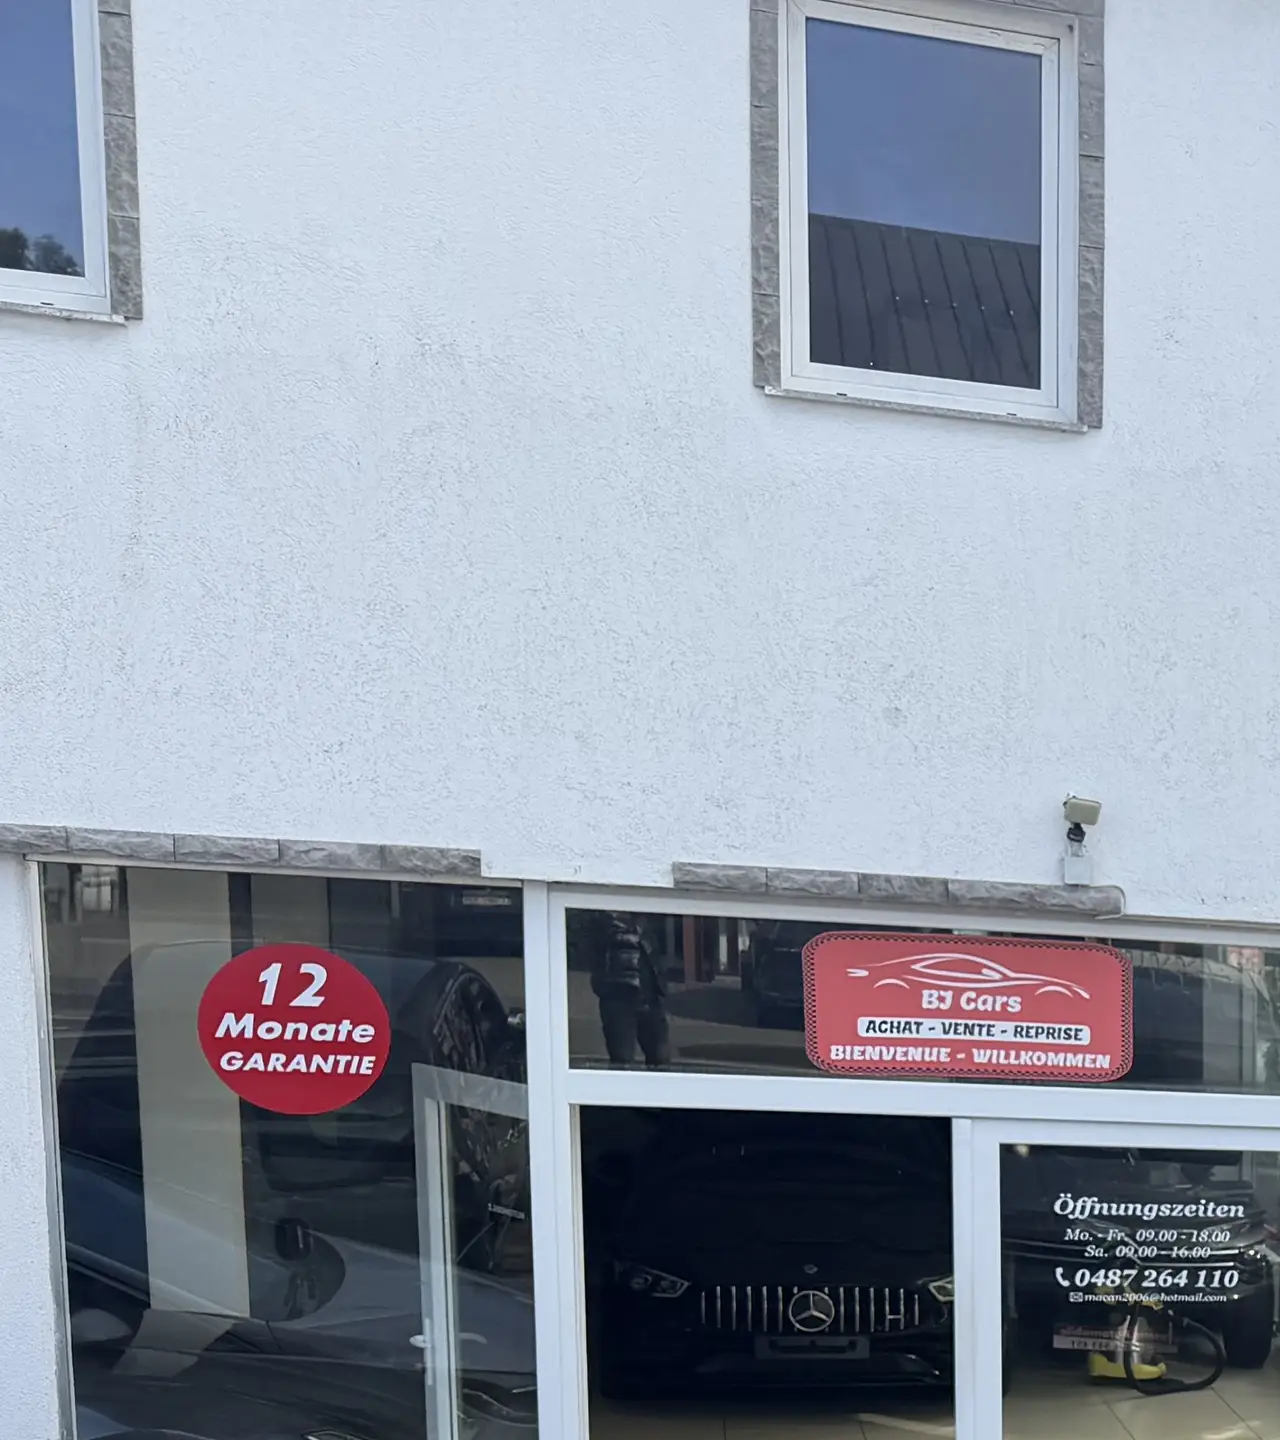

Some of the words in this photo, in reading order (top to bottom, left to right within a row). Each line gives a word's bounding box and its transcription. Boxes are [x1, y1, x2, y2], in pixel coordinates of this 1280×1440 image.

[258, 962, 328, 1008] 12
[921, 989, 953, 1010] BJ
[959, 991, 1022, 1013] Cars
[214, 1012, 376, 1044] Monate
[865, 1020, 924, 1036] ACHAT
[940, 1022, 996, 1038] VENTE
[1013, 1025, 1084, 1041] REPRISE
[219, 1051, 377, 1075] GARANTIE
[829, 1045, 952, 1063] BIENVENUE
[971, 1048, 1111, 1069] WILLKOMMEN
[1053, 1193, 1245, 1220] Öffnungszeiten
[1064, 1229, 1093, 1241] Mo.
[1135, 1229, 1178, 1242] 09.00
[1191, 1229, 1231, 1243] 18.00
[1084, 1245, 1108, 1257] Sa.
[1115, 1245, 1158, 1258] 09.00
[1170, 1246, 1211, 1258] 16.00
[1074, 1268, 1138, 1288] 0487
[1141, 1269, 1188, 1288] 264
[1194, 1269, 1239, 1288] 110
